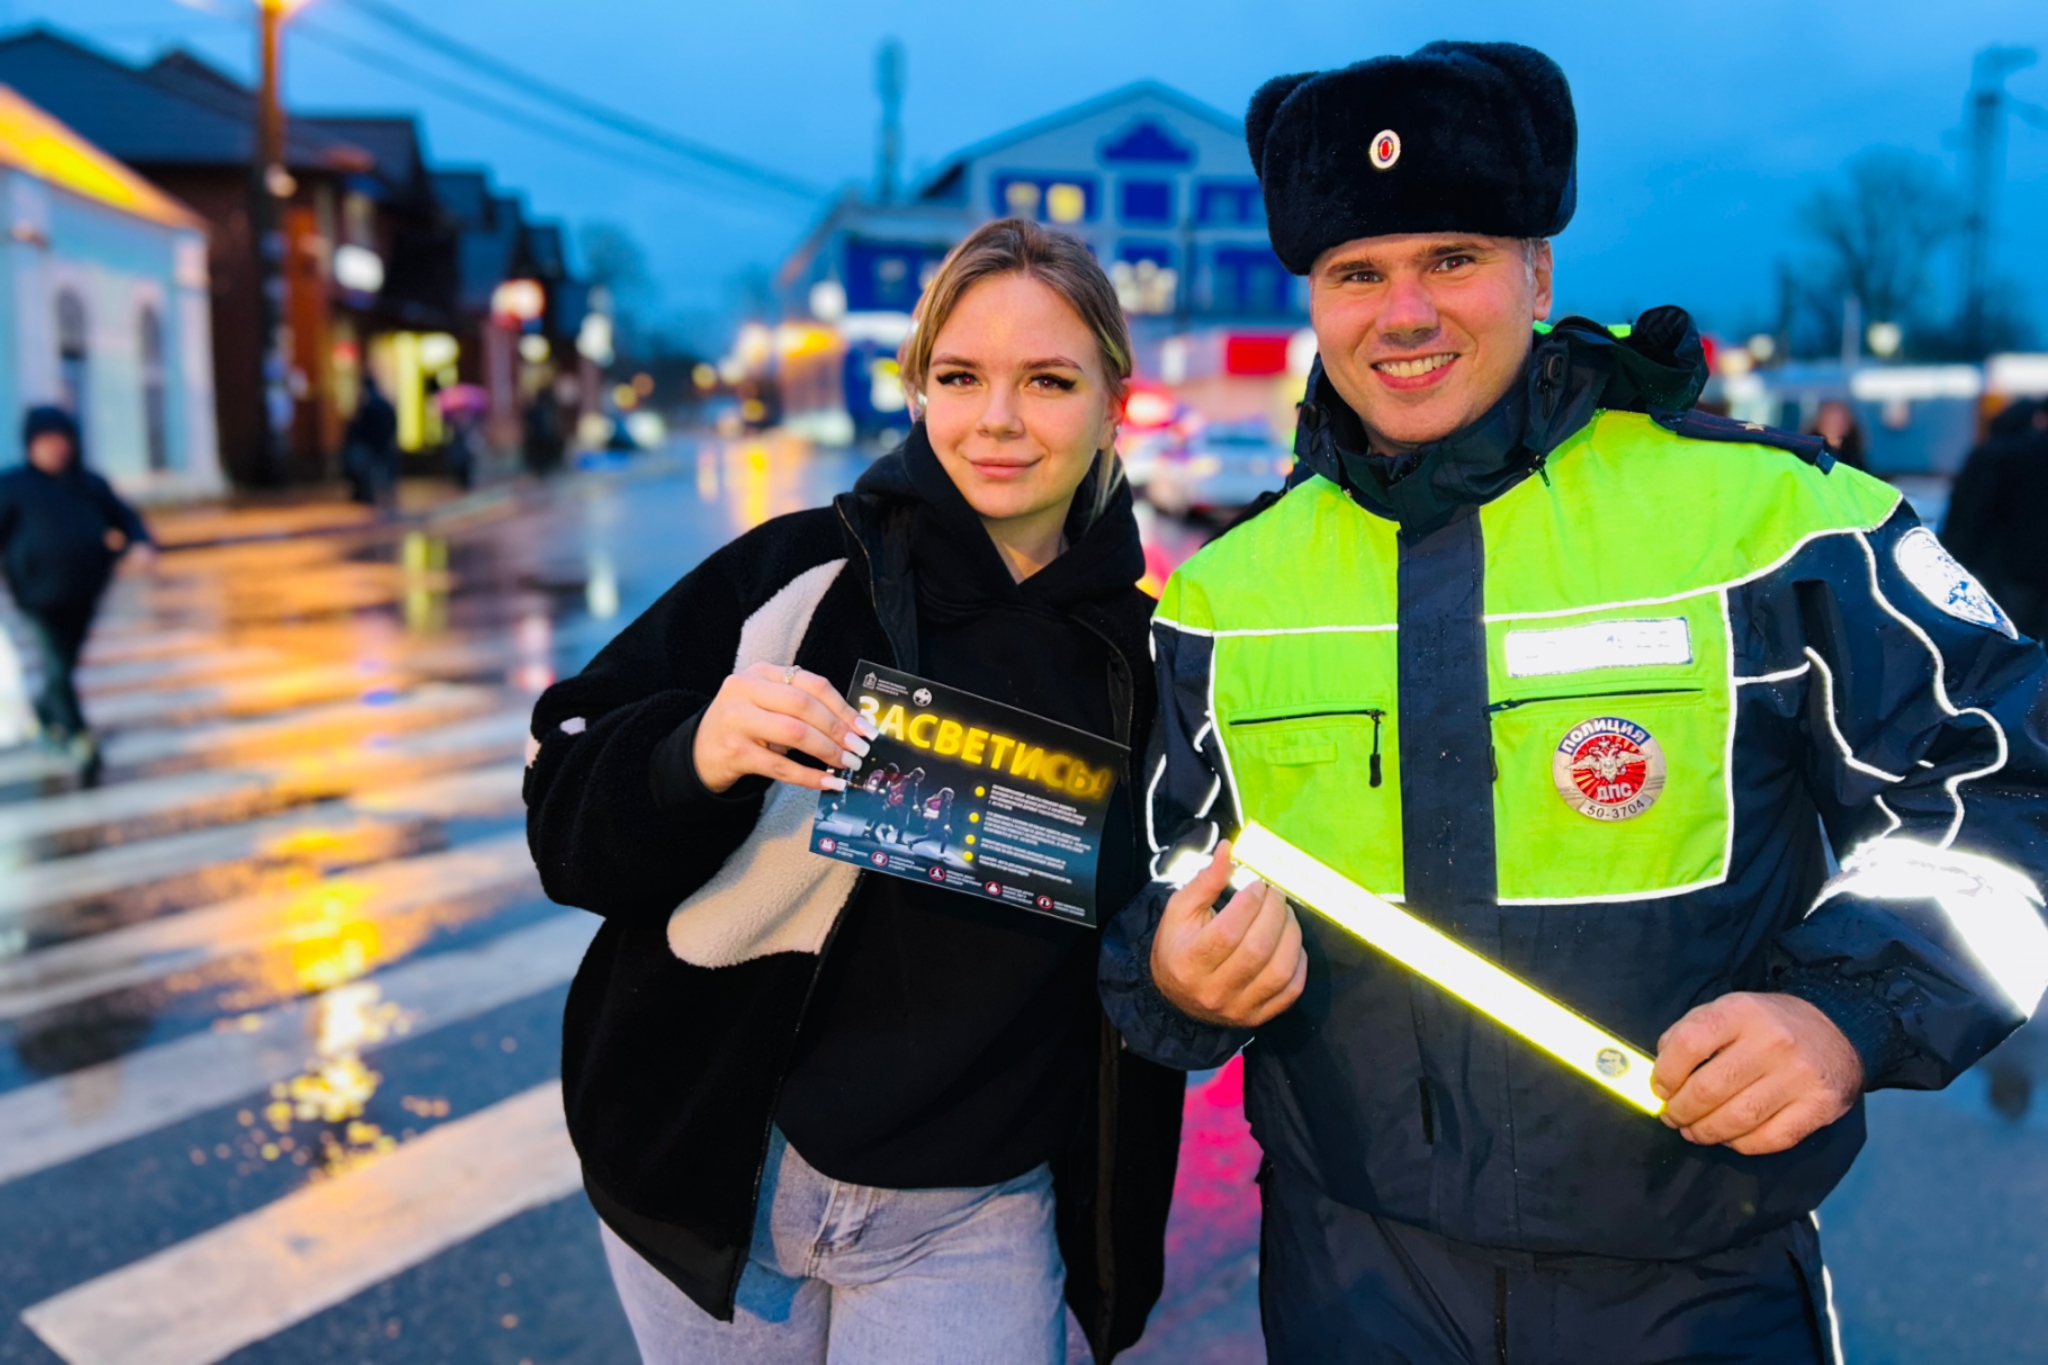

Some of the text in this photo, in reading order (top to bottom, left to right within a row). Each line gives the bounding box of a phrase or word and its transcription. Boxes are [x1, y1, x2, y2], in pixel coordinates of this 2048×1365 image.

[1561, 719, 1647, 753] ПОЛИЦИЯ
[1597, 782, 1632, 801] ДПС
[1587, 799, 1645, 819] 50-3704
